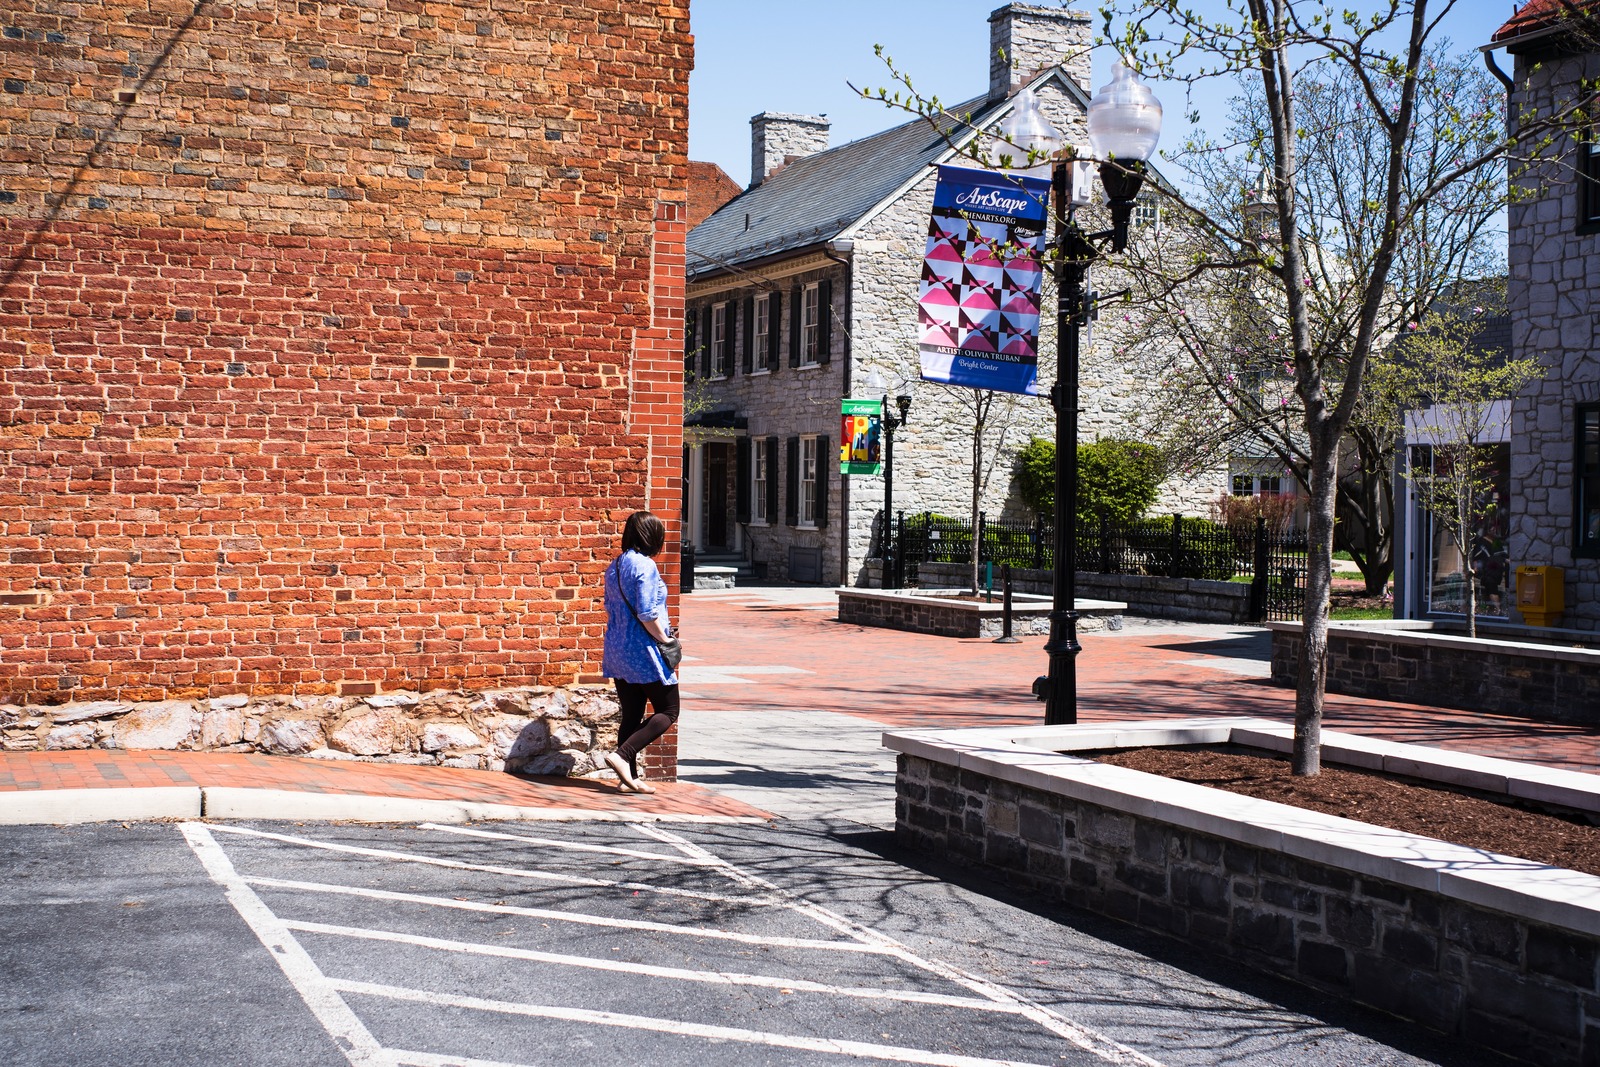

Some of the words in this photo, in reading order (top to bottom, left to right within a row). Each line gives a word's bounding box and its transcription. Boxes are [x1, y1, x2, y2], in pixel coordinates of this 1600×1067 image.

[955, 187, 1028, 214] ArtScape
[964, 210, 1017, 225] HENARTS.ORG
[936, 346, 963, 355] ARTIST:
[964, 349, 990, 359] OLIVIA
[991, 353, 1020, 363] TRUBAN
[958, 358, 979, 370] Bright
[979, 361, 999, 371] Center
